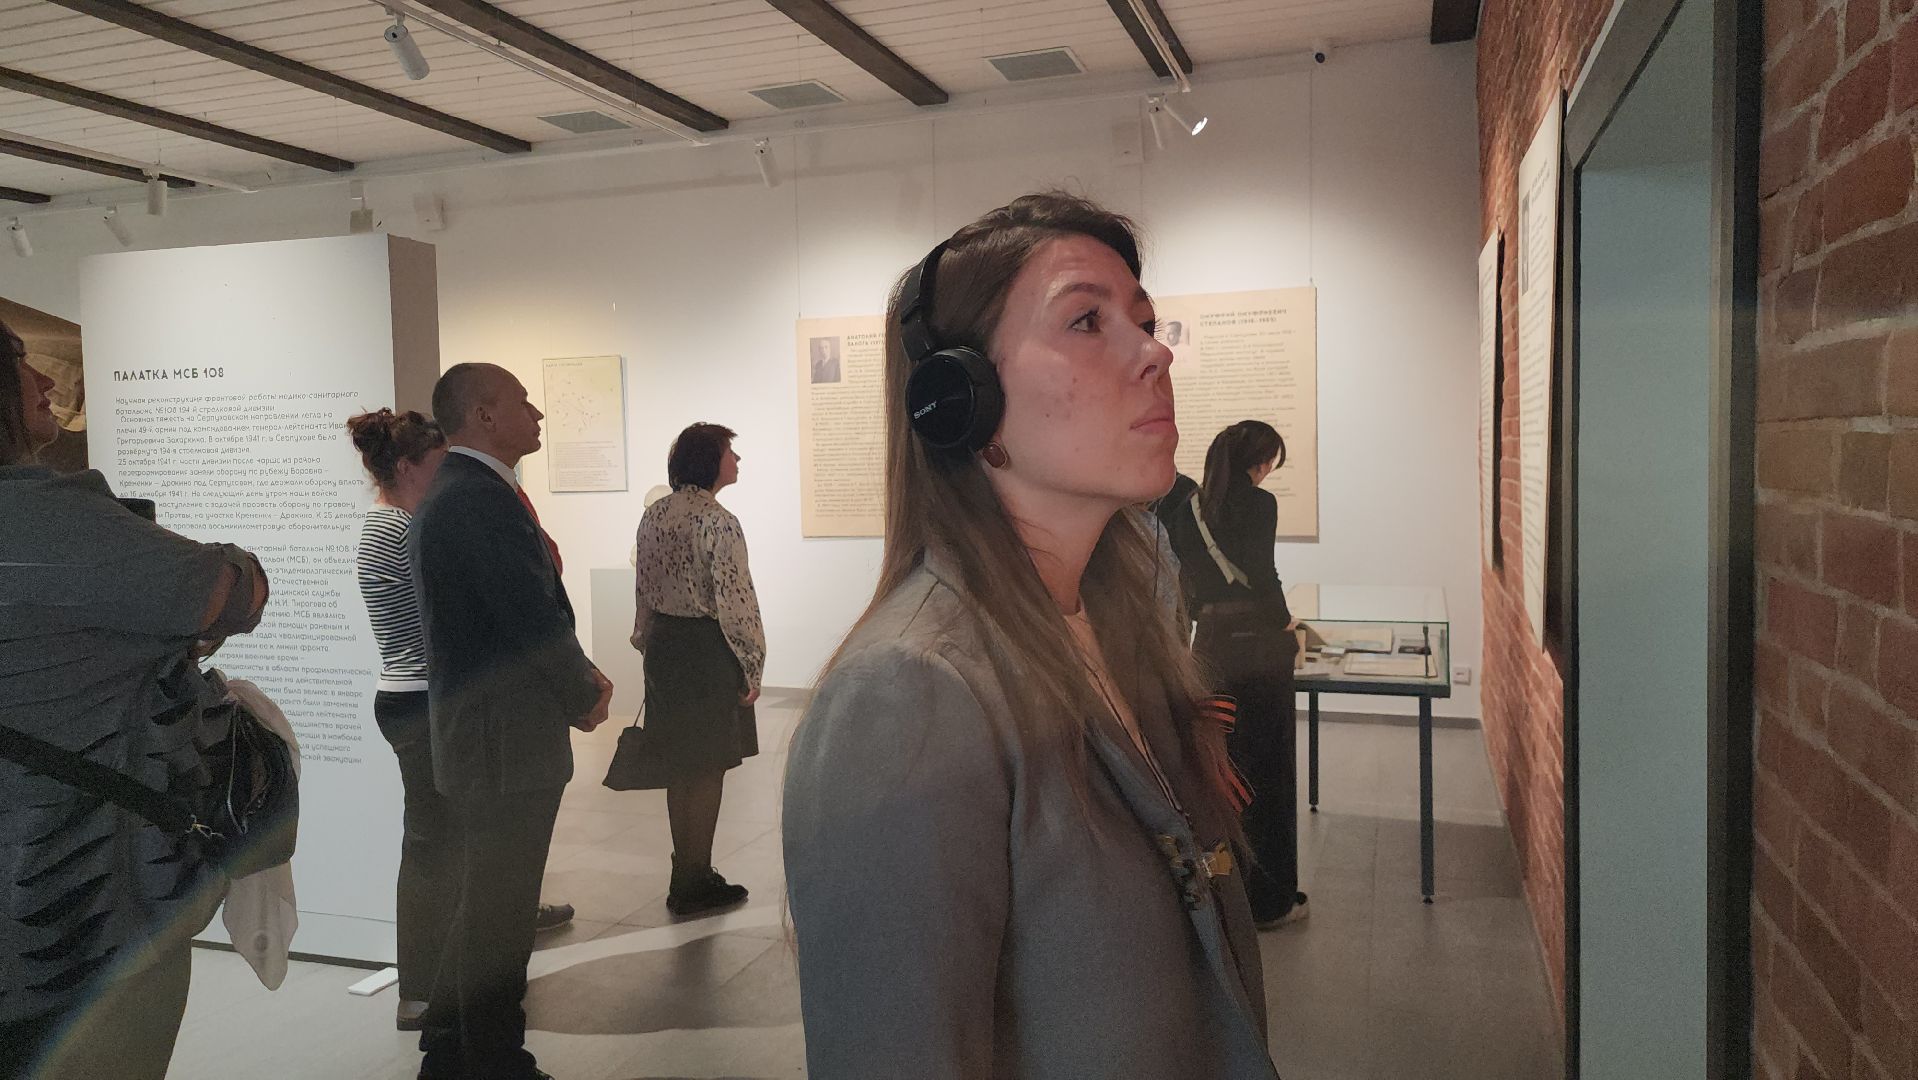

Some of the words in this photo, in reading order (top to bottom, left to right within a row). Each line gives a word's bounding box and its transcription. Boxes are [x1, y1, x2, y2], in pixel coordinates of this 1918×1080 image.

[114, 368, 168, 380] ПАЛАТКА
[173, 368, 199, 379] МСБ
[203, 366, 224, 378] 108
[115, 396, 146, 405] Научная
[204, 393, 245, 403] фронтовой
[249, 392, 277, 402] работы
[199, 404, 242, 414] стрелковой
[913, 401, 937, 419] SONY
[196, 412, 249, 422] Серпуховском
[250, 413, 298, 421] направлении
[116, 436, 164, 445] Григорьевича
[214, 434, 244, 444] октябре
[275, 433, 316, 443] Серпухове
[128, 458, 156, 467] октября
[294, 456, 321, 465] района
[216, 467, 247, 476] оборону
[259, 467, 288, 476] рубежу
[304, 478, 337, 487] оборону
[139, 489, 166, 498] декабря
[203, 489, 244, 498] следующий
[278, 500, 310, 509] оборону
[270, 588, 310, 597] дицинской
[312, 589, 340, 598] службы
[300, 643, 329, 653] фронта
